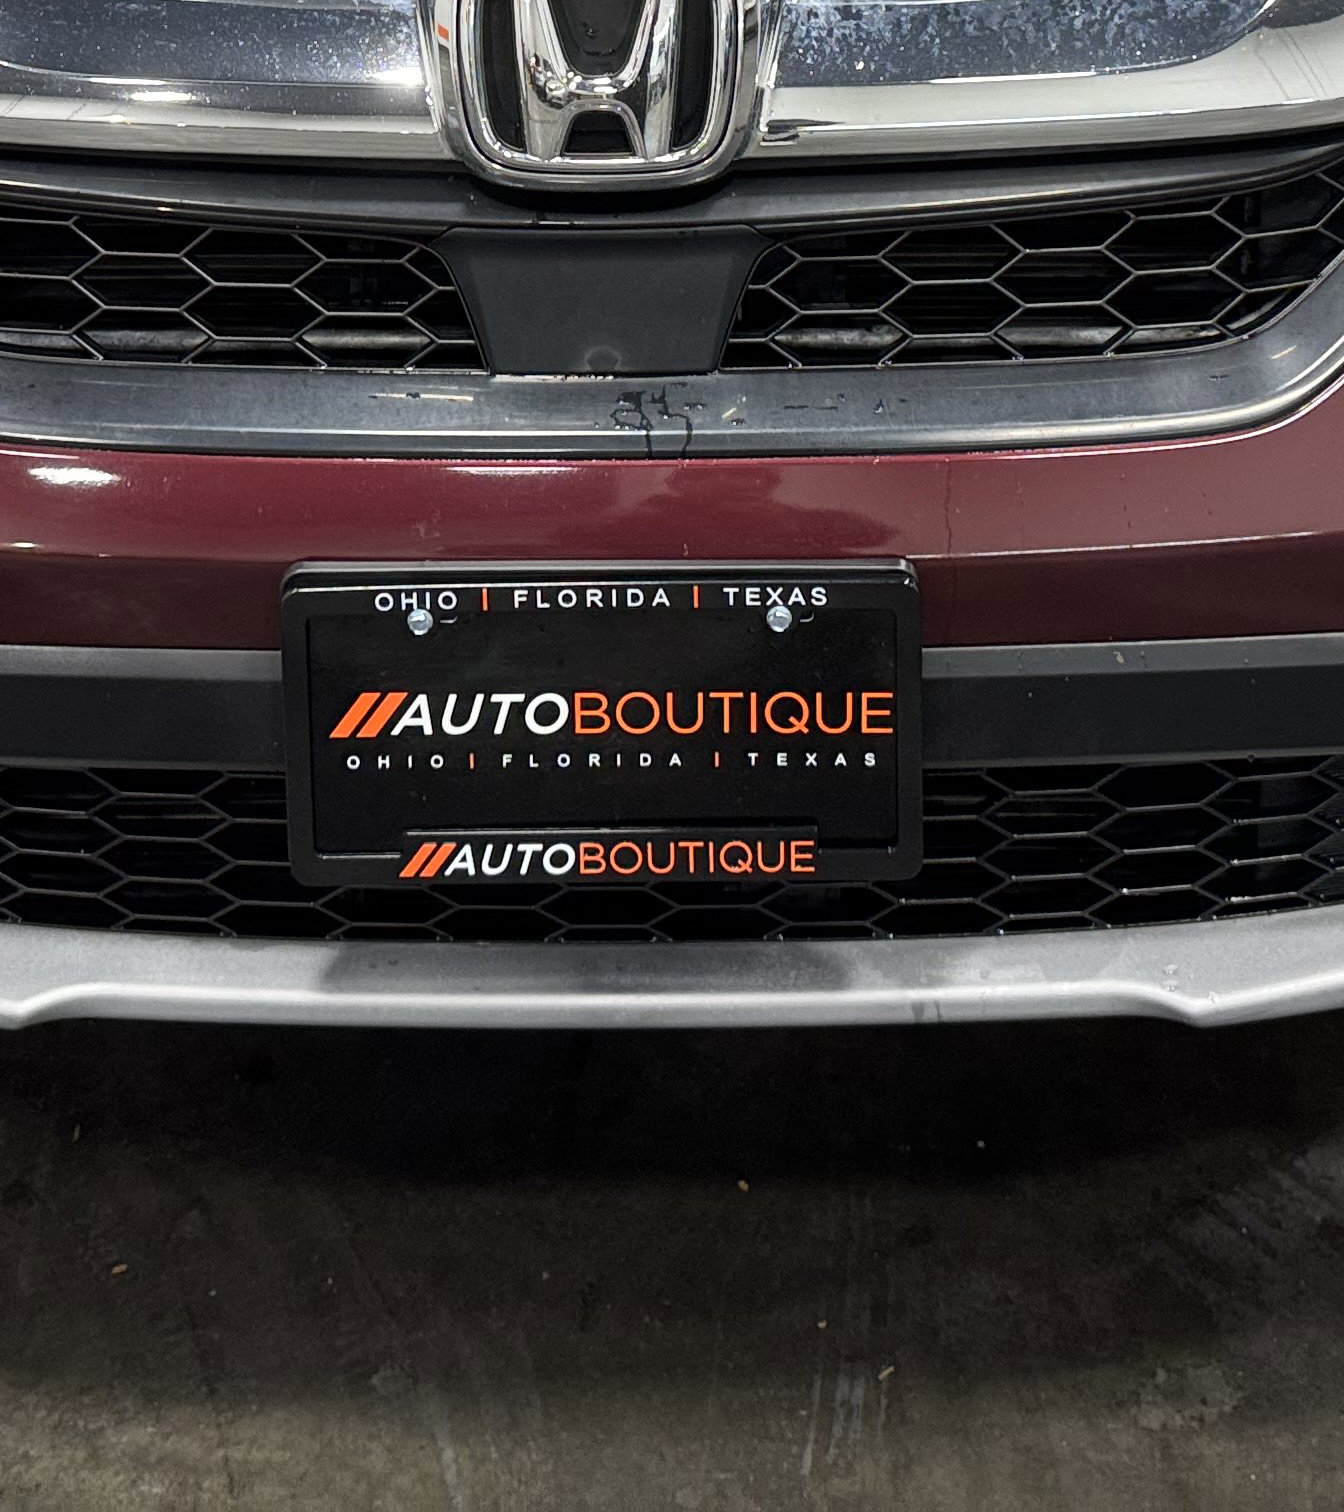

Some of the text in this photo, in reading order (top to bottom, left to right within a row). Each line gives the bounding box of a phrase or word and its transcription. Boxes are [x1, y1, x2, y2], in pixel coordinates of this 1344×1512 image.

[374, 586, 828, 612] OHIO FLORIDA TEXAS
[390, 691, 894, 736] AUTOBOUTIQUE
[346, 752, 876, 770] OHIO FLORIDA TEXAS
[443, 840, 816, 877] AUTOBOUTIQUE
